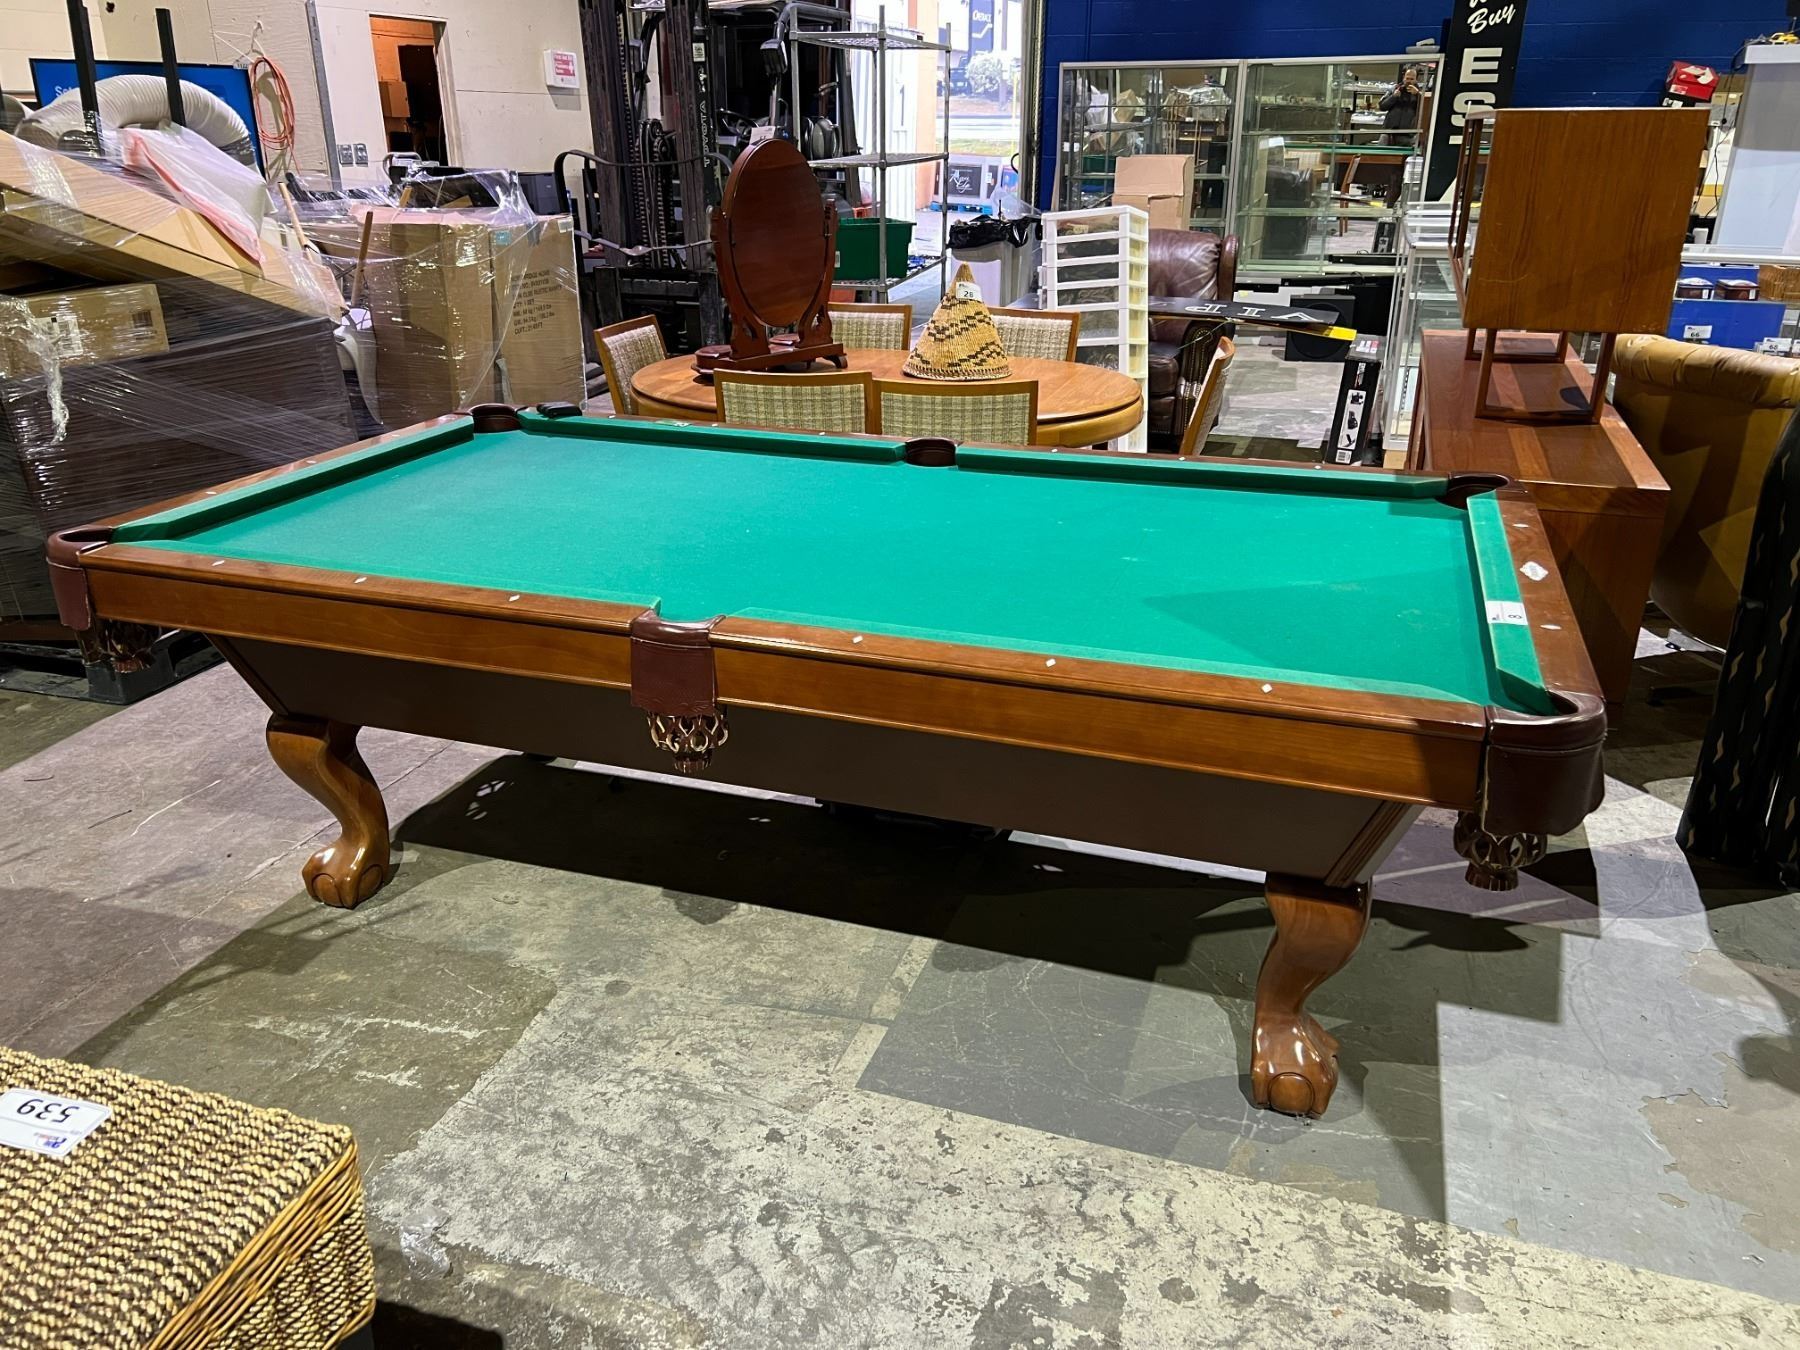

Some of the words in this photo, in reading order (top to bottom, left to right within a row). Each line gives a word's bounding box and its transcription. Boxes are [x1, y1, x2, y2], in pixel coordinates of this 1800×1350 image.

[1467, 4, 1516, 34] Buy
[700, 100, 710, 168] TOYOTA
[964, 290, 974, 298] 28
[16, 1098, 80, 1123] 539
